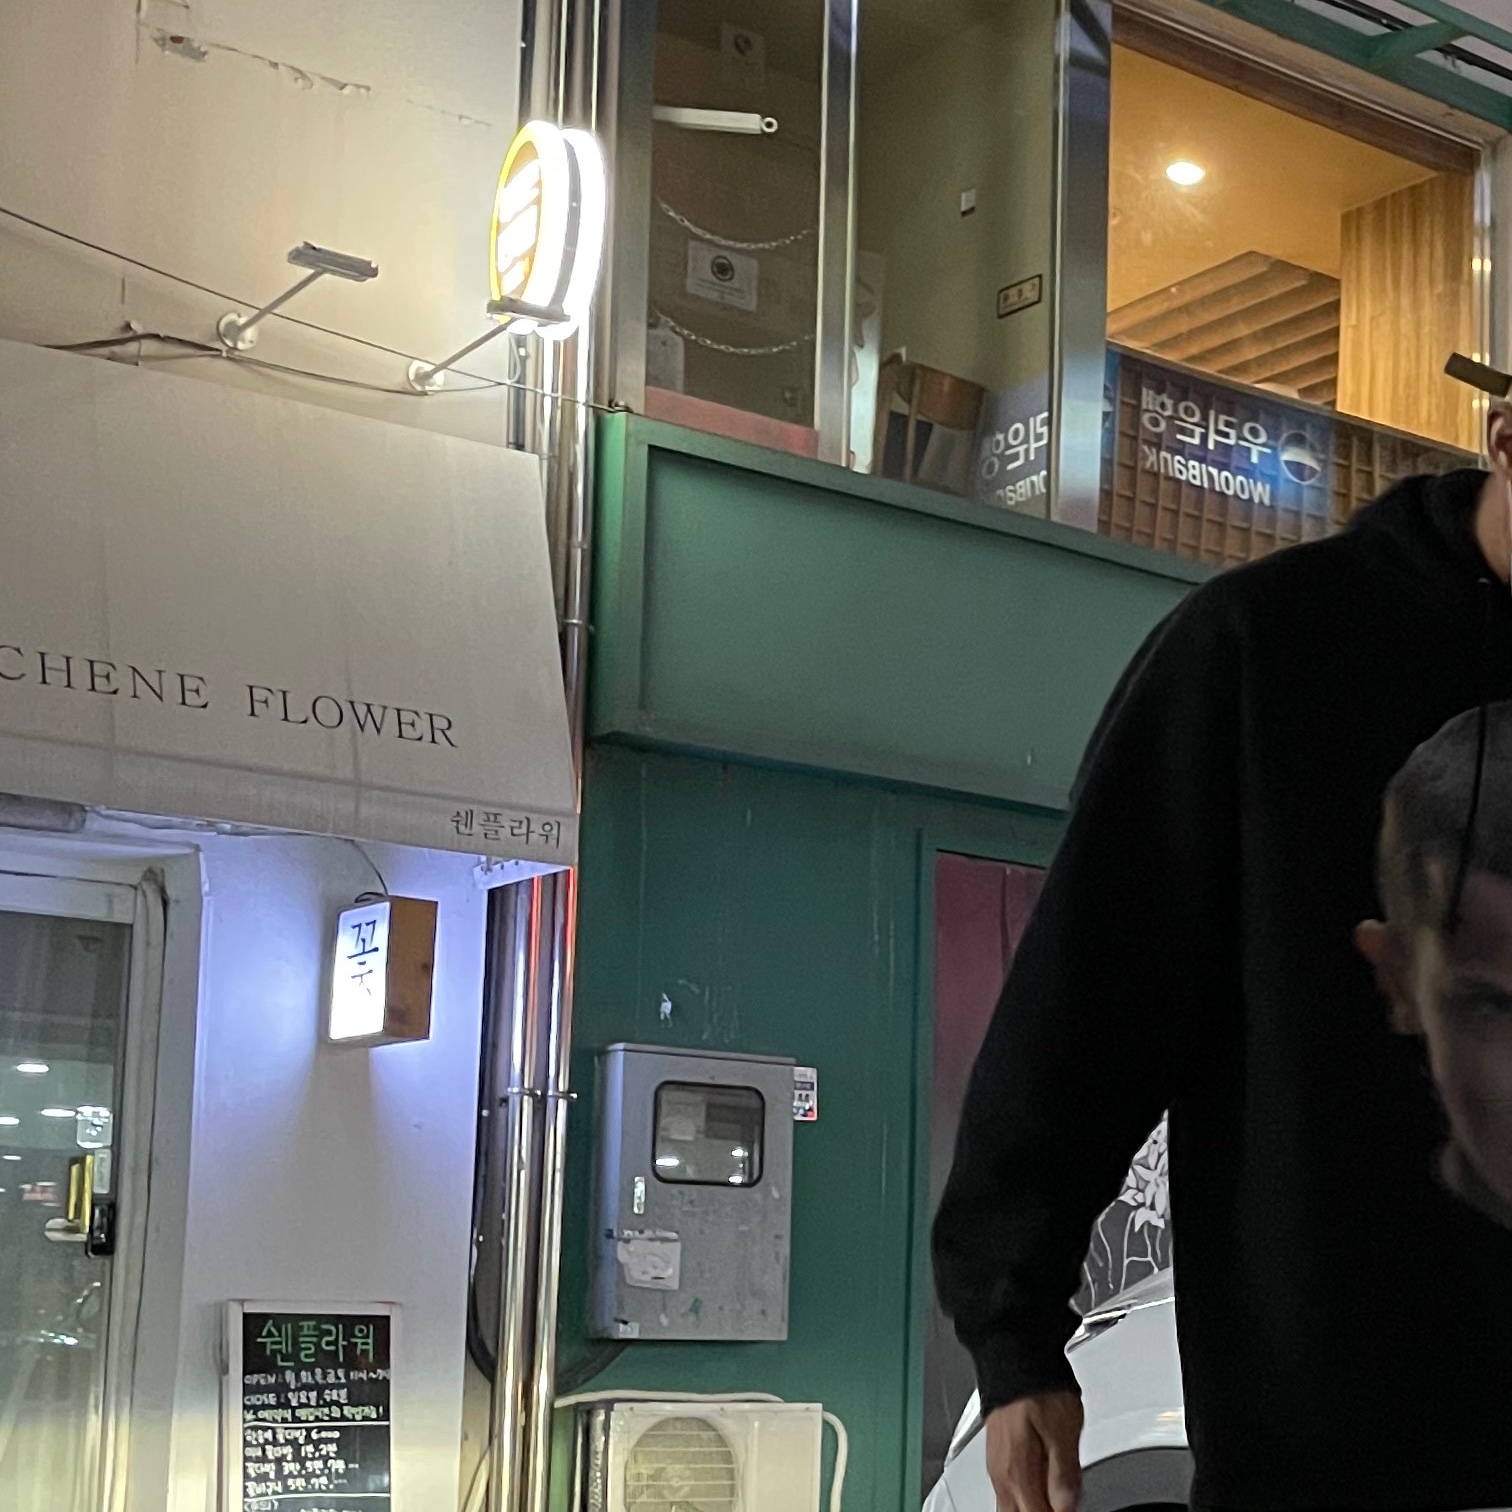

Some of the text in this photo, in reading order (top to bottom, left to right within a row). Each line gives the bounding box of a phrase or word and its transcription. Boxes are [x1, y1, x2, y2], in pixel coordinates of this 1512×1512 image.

[0, 644, 459, 748] CHENE FLOWER
[256, 1319, 374, 1367] 쉔플라워
